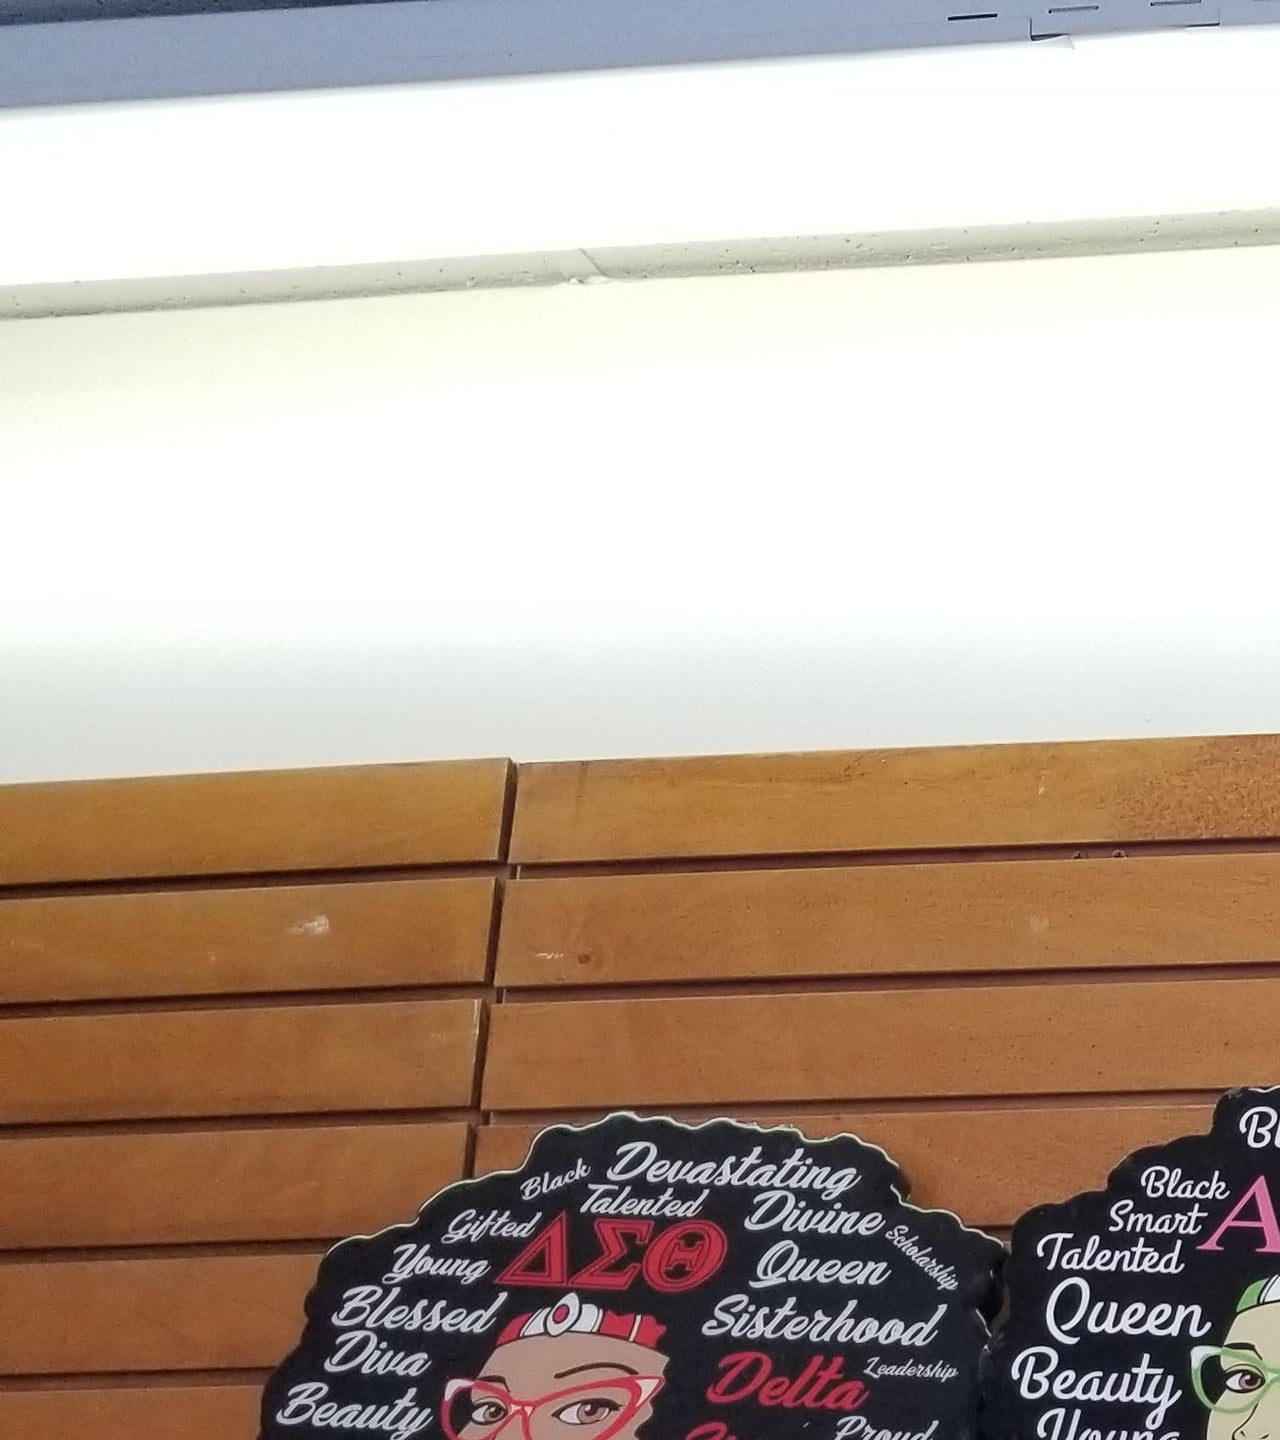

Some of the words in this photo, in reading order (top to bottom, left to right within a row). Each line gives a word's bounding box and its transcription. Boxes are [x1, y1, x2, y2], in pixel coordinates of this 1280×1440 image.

[520, 1158, 591, 1200] Black
[607, 1142, 861, 1200] Devastating
[1141, 1166, 1230, 1199] Black
[580, 1184, 709, 1217] Talented
[744, 1190, 886, 1235] Divine
[1109, 1200, 1208, 1234] Smart
[442, 1209, 542, 1243] Gifted
[391, 1244, 491, 1285] Young
[749, 1240, 891, 1288] Queen
[885, 1225, 958, 1290] Scholarship
[1037, 1233, 1184, 1273] Talented
[332, 1285, 508, 1333] Blessed
[702, 1294, 947, 1346] Sisterhood
[1046, 1277, 1211, 1344] Queen
[324, 1330, 431, 1376] Diva
[864, 1357, 958, 1382] Leadership
[707, 1352, 868, 1410] Delta
[1011, 1346, 1182, 1430] Beauty
